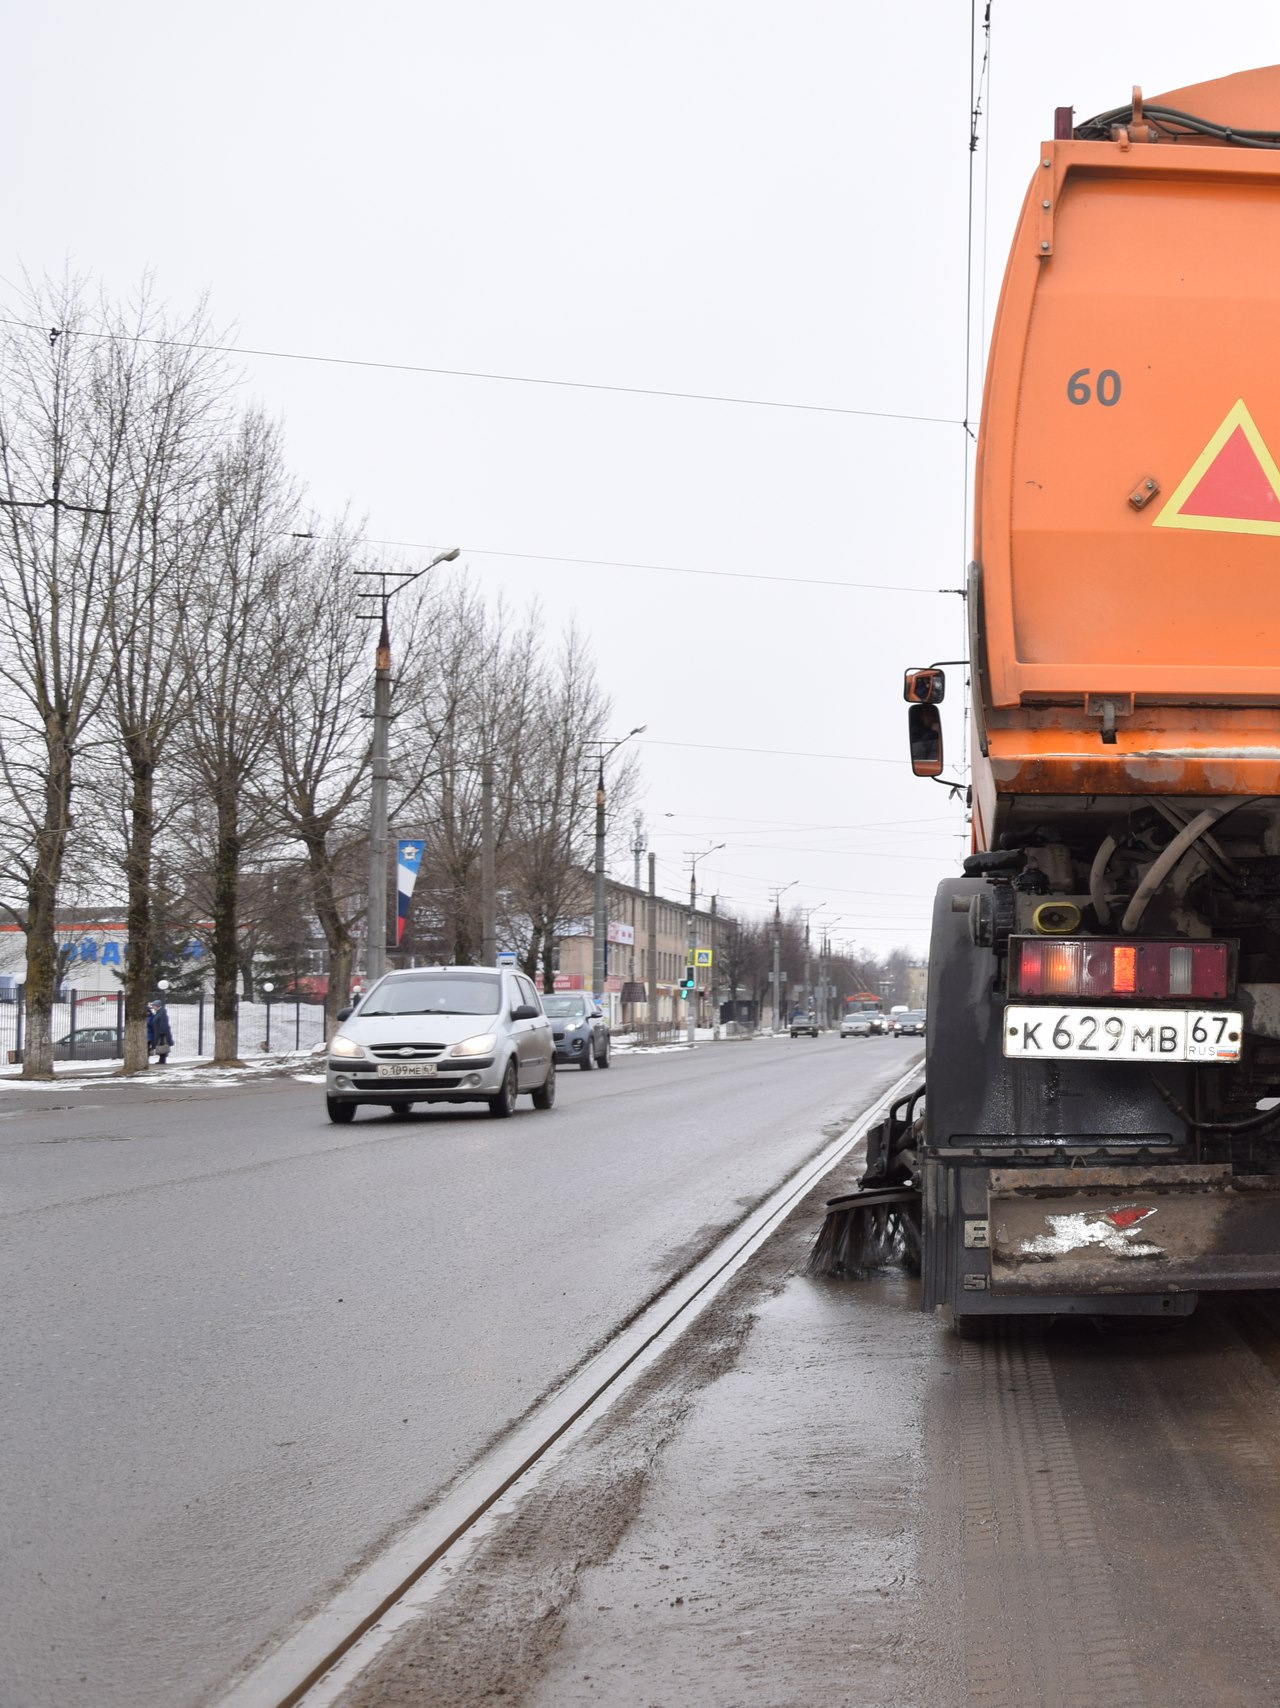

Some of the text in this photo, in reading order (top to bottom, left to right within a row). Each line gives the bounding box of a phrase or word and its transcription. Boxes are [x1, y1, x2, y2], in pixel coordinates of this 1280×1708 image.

[1066, 367, 1122, 407] 60
[1023, 1014, 1228, 1053] К629МВ 67
[1188, 1046, 1215, 1056] RUS
